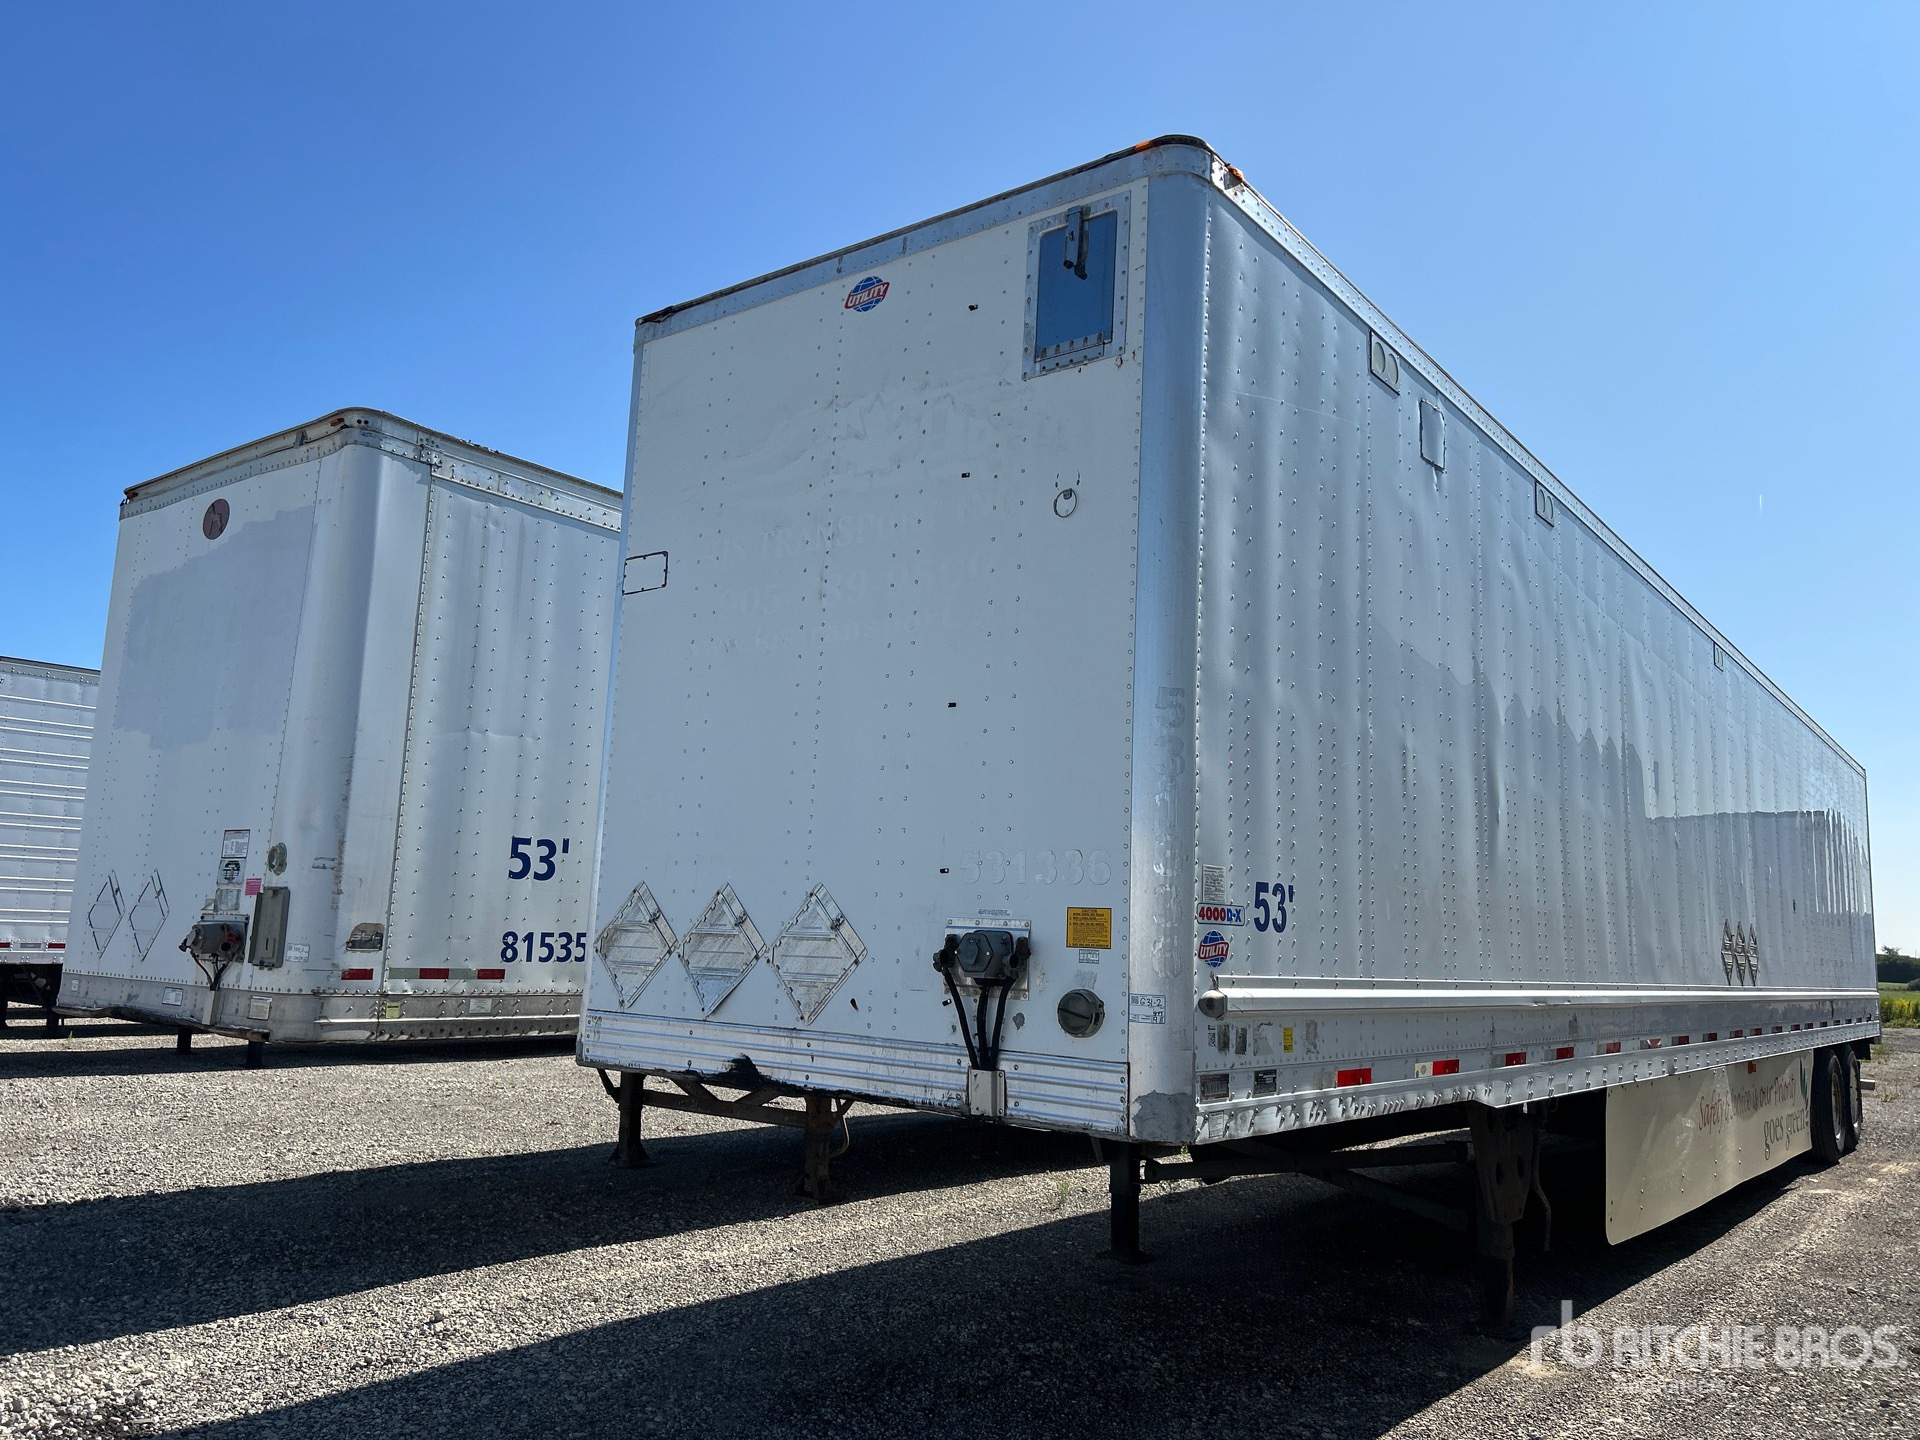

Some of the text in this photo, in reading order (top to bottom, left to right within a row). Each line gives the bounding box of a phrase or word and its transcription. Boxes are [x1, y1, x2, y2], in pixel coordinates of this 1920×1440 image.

[847, 284, 887, 307] UTILITY
[508, 837, 570, 881] 53'
[960, 849, 1113, 885] 531336
[1199, 907, 1242, 922] 4000D-X
[1254, 882, 1294, 933] 53'
[501, 931, 587, 963] 81535
[1200, 945, 1228, 958] UTILITY
[1764, 1116, 1784, 1160] goes
